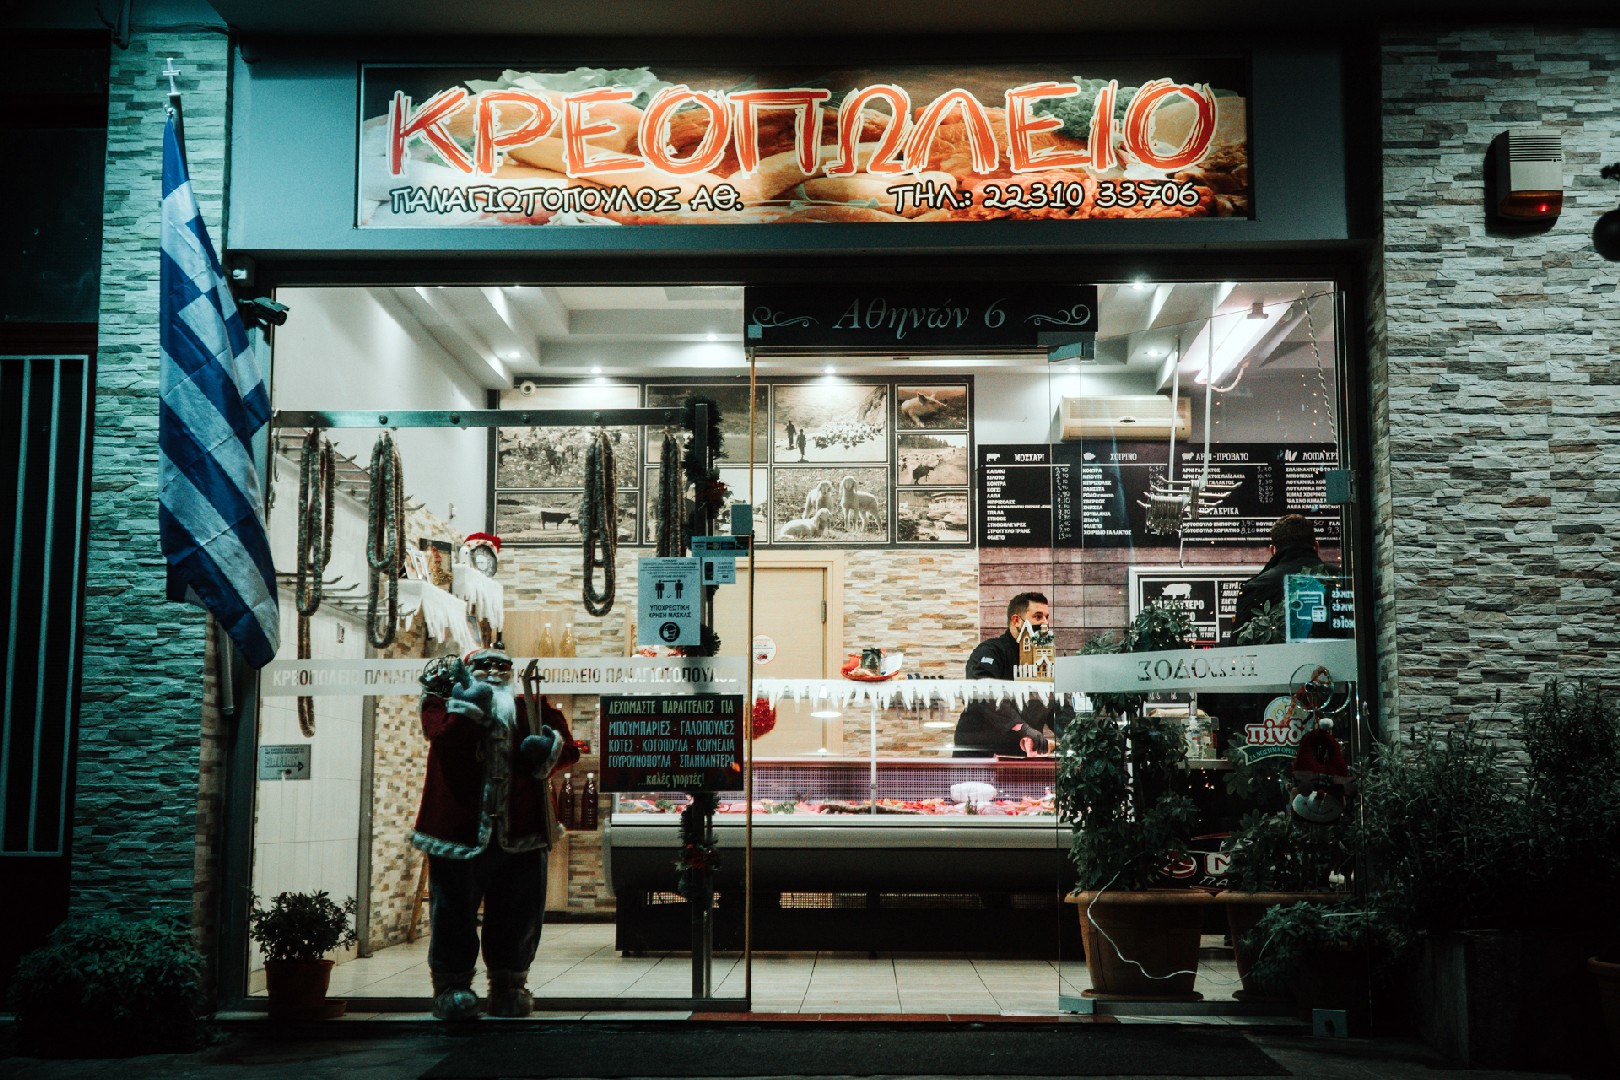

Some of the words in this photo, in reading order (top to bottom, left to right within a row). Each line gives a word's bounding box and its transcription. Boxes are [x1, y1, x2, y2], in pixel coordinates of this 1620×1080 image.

[386, 79, 1216, 176] ΚΡΕΟΠΩΛΕΙΟ
[390, 186, 681, 215] ΠΑΝΑΓΙΩΤΟΠΟΥΛΟΣ
[690, 185, 744, 213] ΑΘ.
[983, 182, 1084, 210] 22310
[1096, 182, 1200, 209] 33706
[832, 298, 970, 340] Αθηνών
[984, 298, 1007, 329] 6
[608, 700, 656, 714] ΔΕΧΟΜΑΣΤΕ
[662, 700, 714, 714] ΠΑΡΑΓΓΕΛΙΕΣ
[720, 700, 734, 714] ΓΙΑ
[608, 720, 671, 736] ΜΠΟΥΜΠΑΡΙΕΣ
[680, 720, 735, 735] ΓΑΛΟΠΟΥΛΕΣ
[608, 739, 633, 752] ΚΟΤΕΣ
[642, 739, 688, 752] ΚΟΤΟΠΟΥΛΑ
[696, 739, 735, 752] ΚΟΥΝΕΛΙΑ
